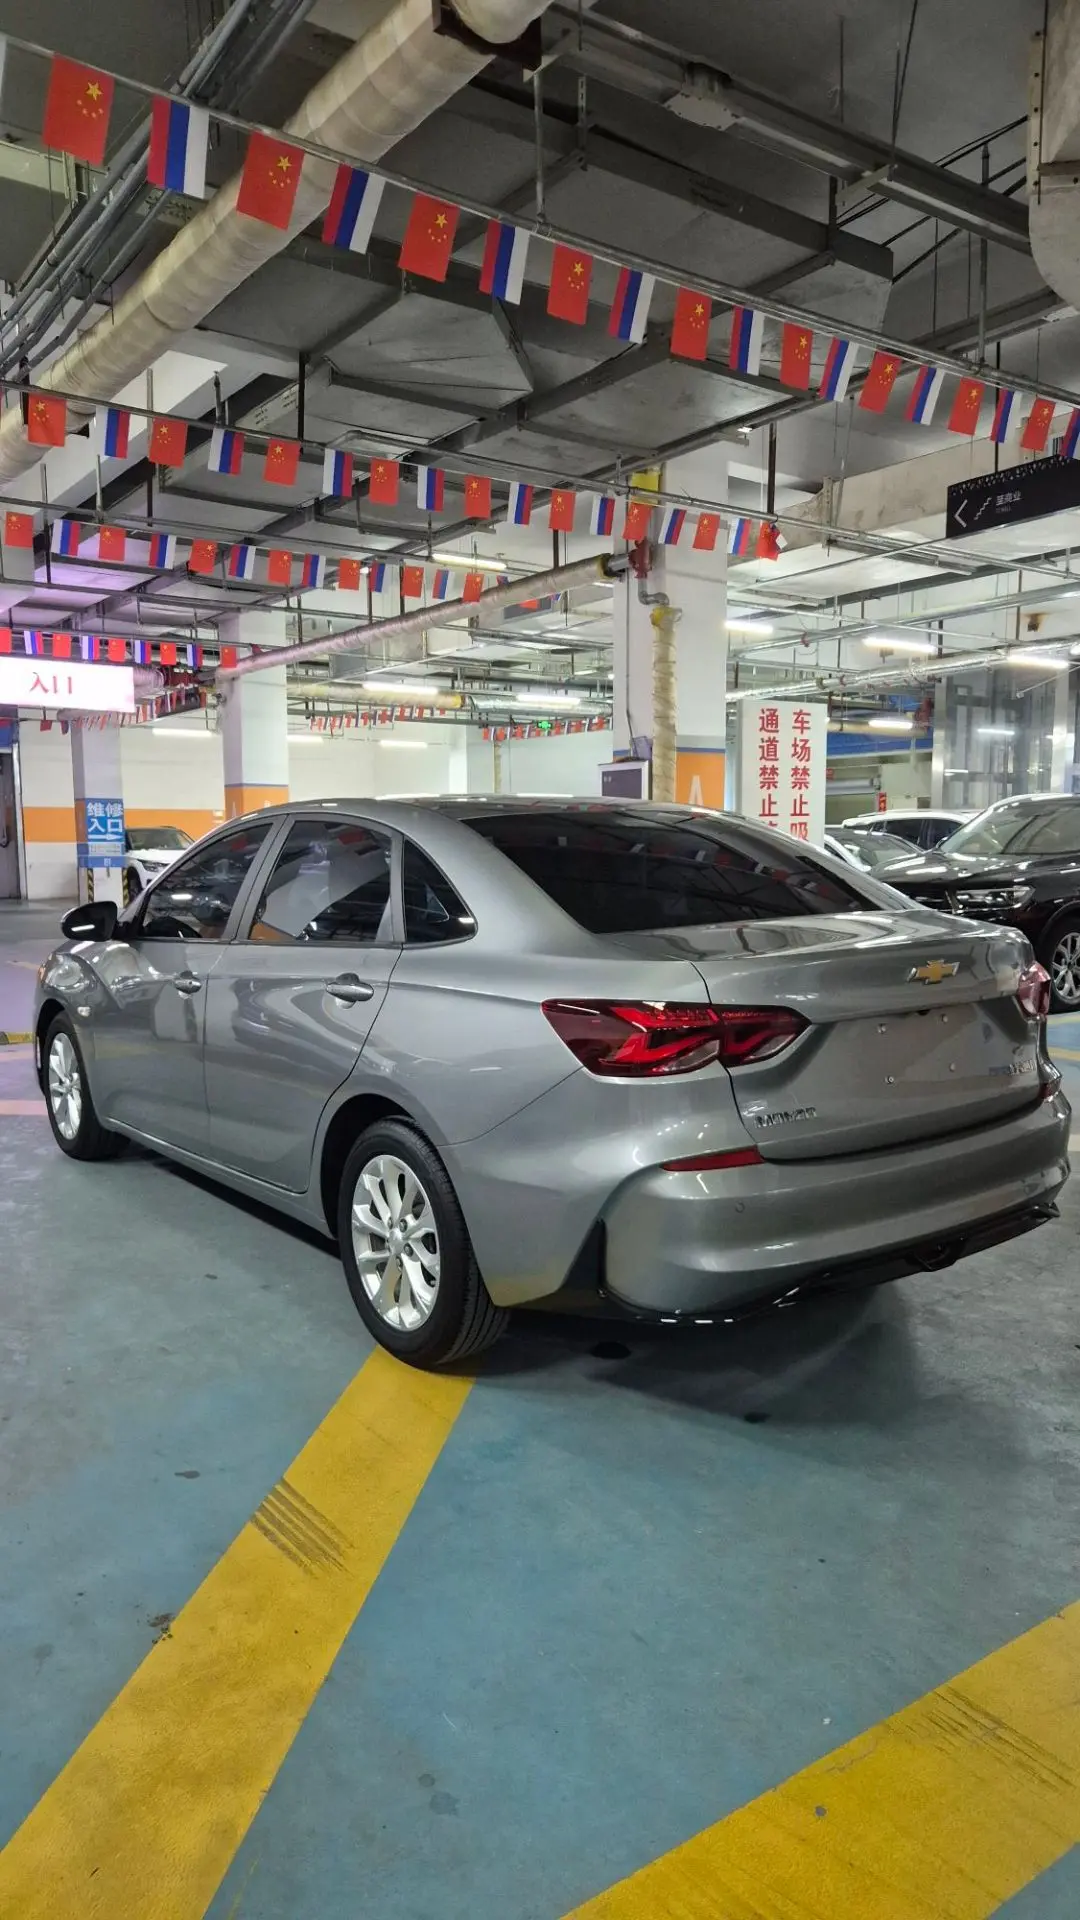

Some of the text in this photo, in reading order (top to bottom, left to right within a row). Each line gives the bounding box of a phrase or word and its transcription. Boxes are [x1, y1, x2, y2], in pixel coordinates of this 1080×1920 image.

[758, 708, 779, 828] 通道禁止
[87, 802, 124, 817] 维修
[88, 818, 123, 832] 入口
